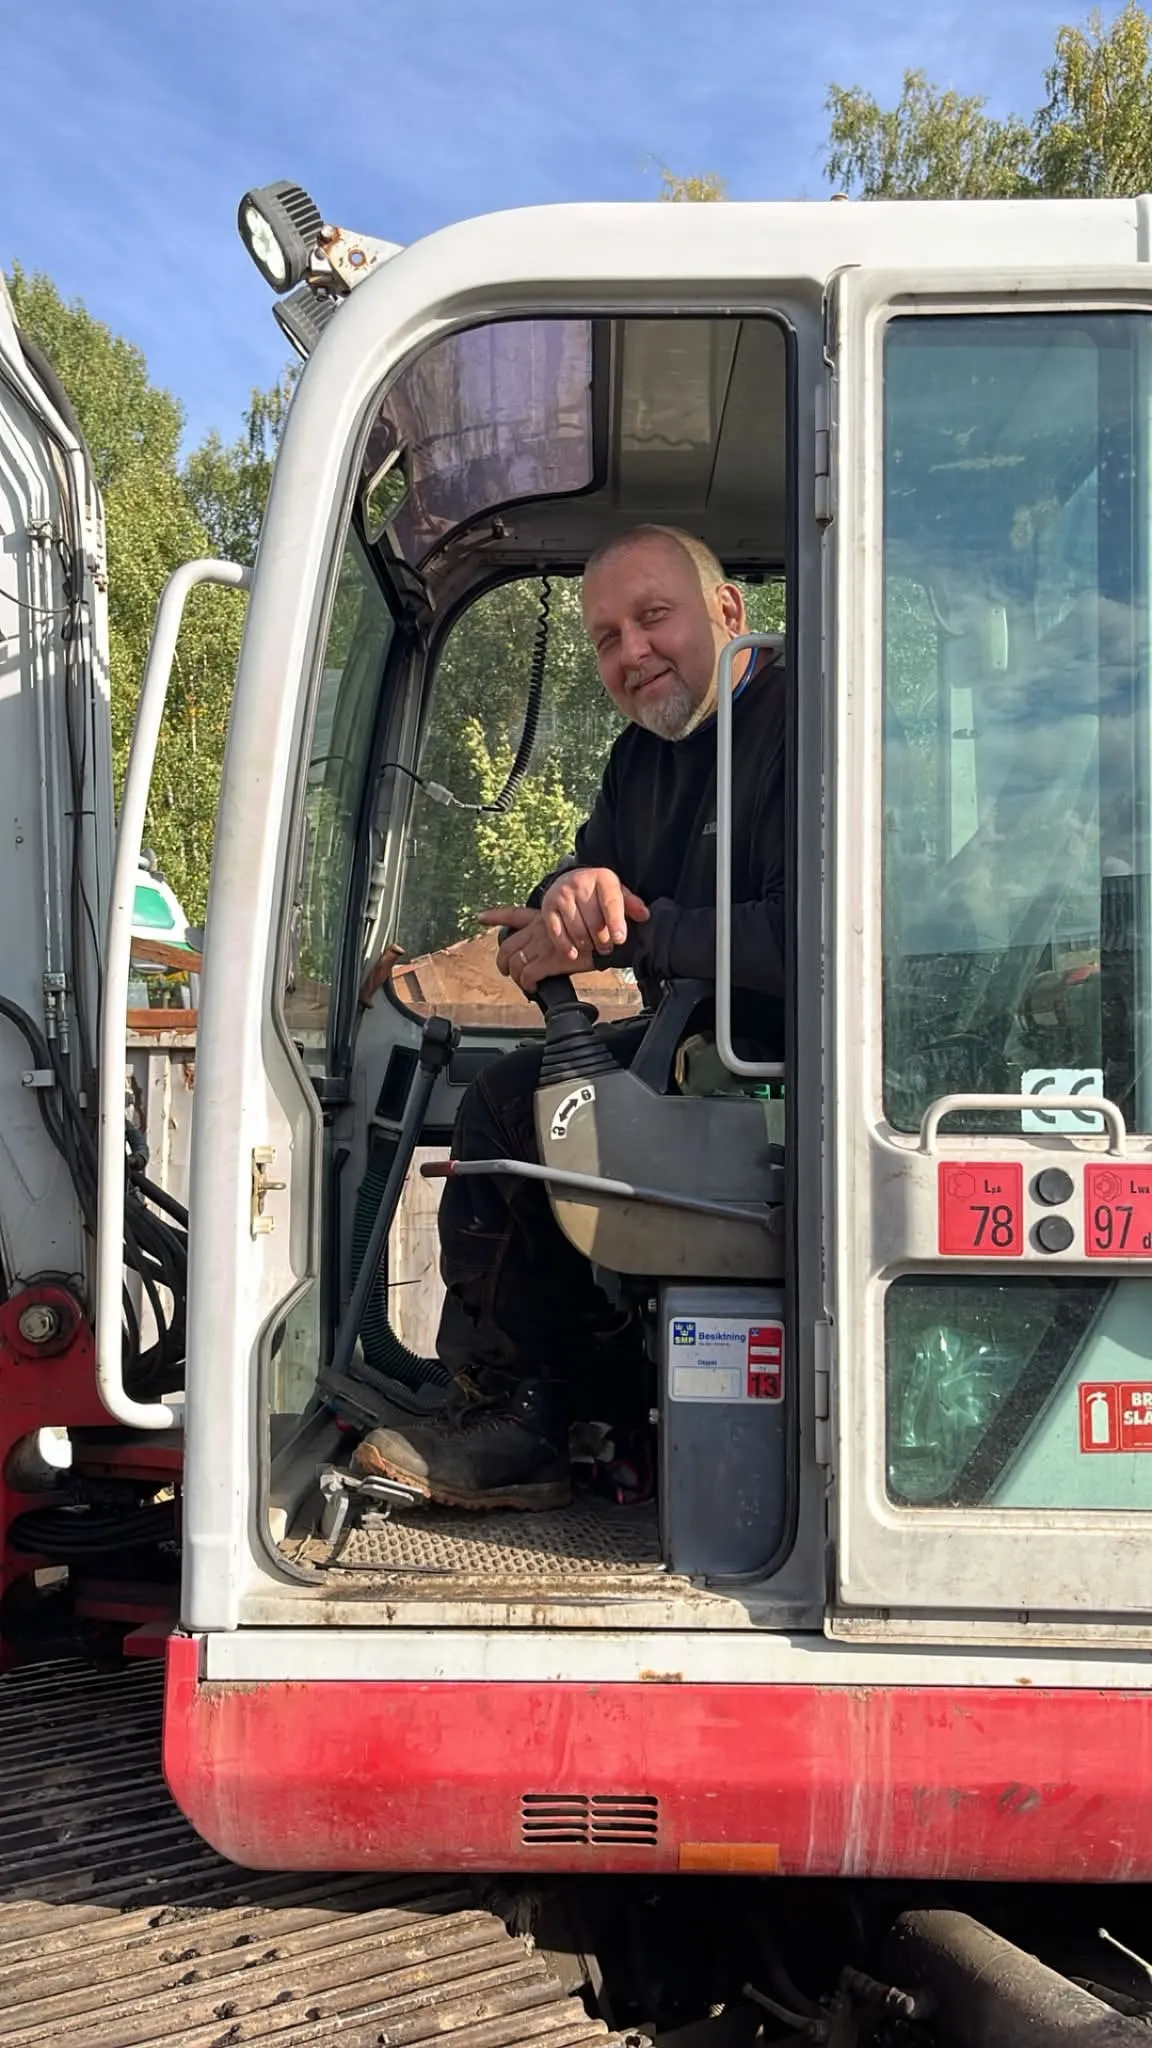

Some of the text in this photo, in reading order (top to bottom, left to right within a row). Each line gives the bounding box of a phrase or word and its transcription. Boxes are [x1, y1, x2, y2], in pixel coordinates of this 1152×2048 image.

[969, 1205, 1014, 1247] 78
[1094, 1205, 1133, 1249] 97
[698, 1332, 746, 1344] Besiktning
[752, 1373, 778, 1398] 13
